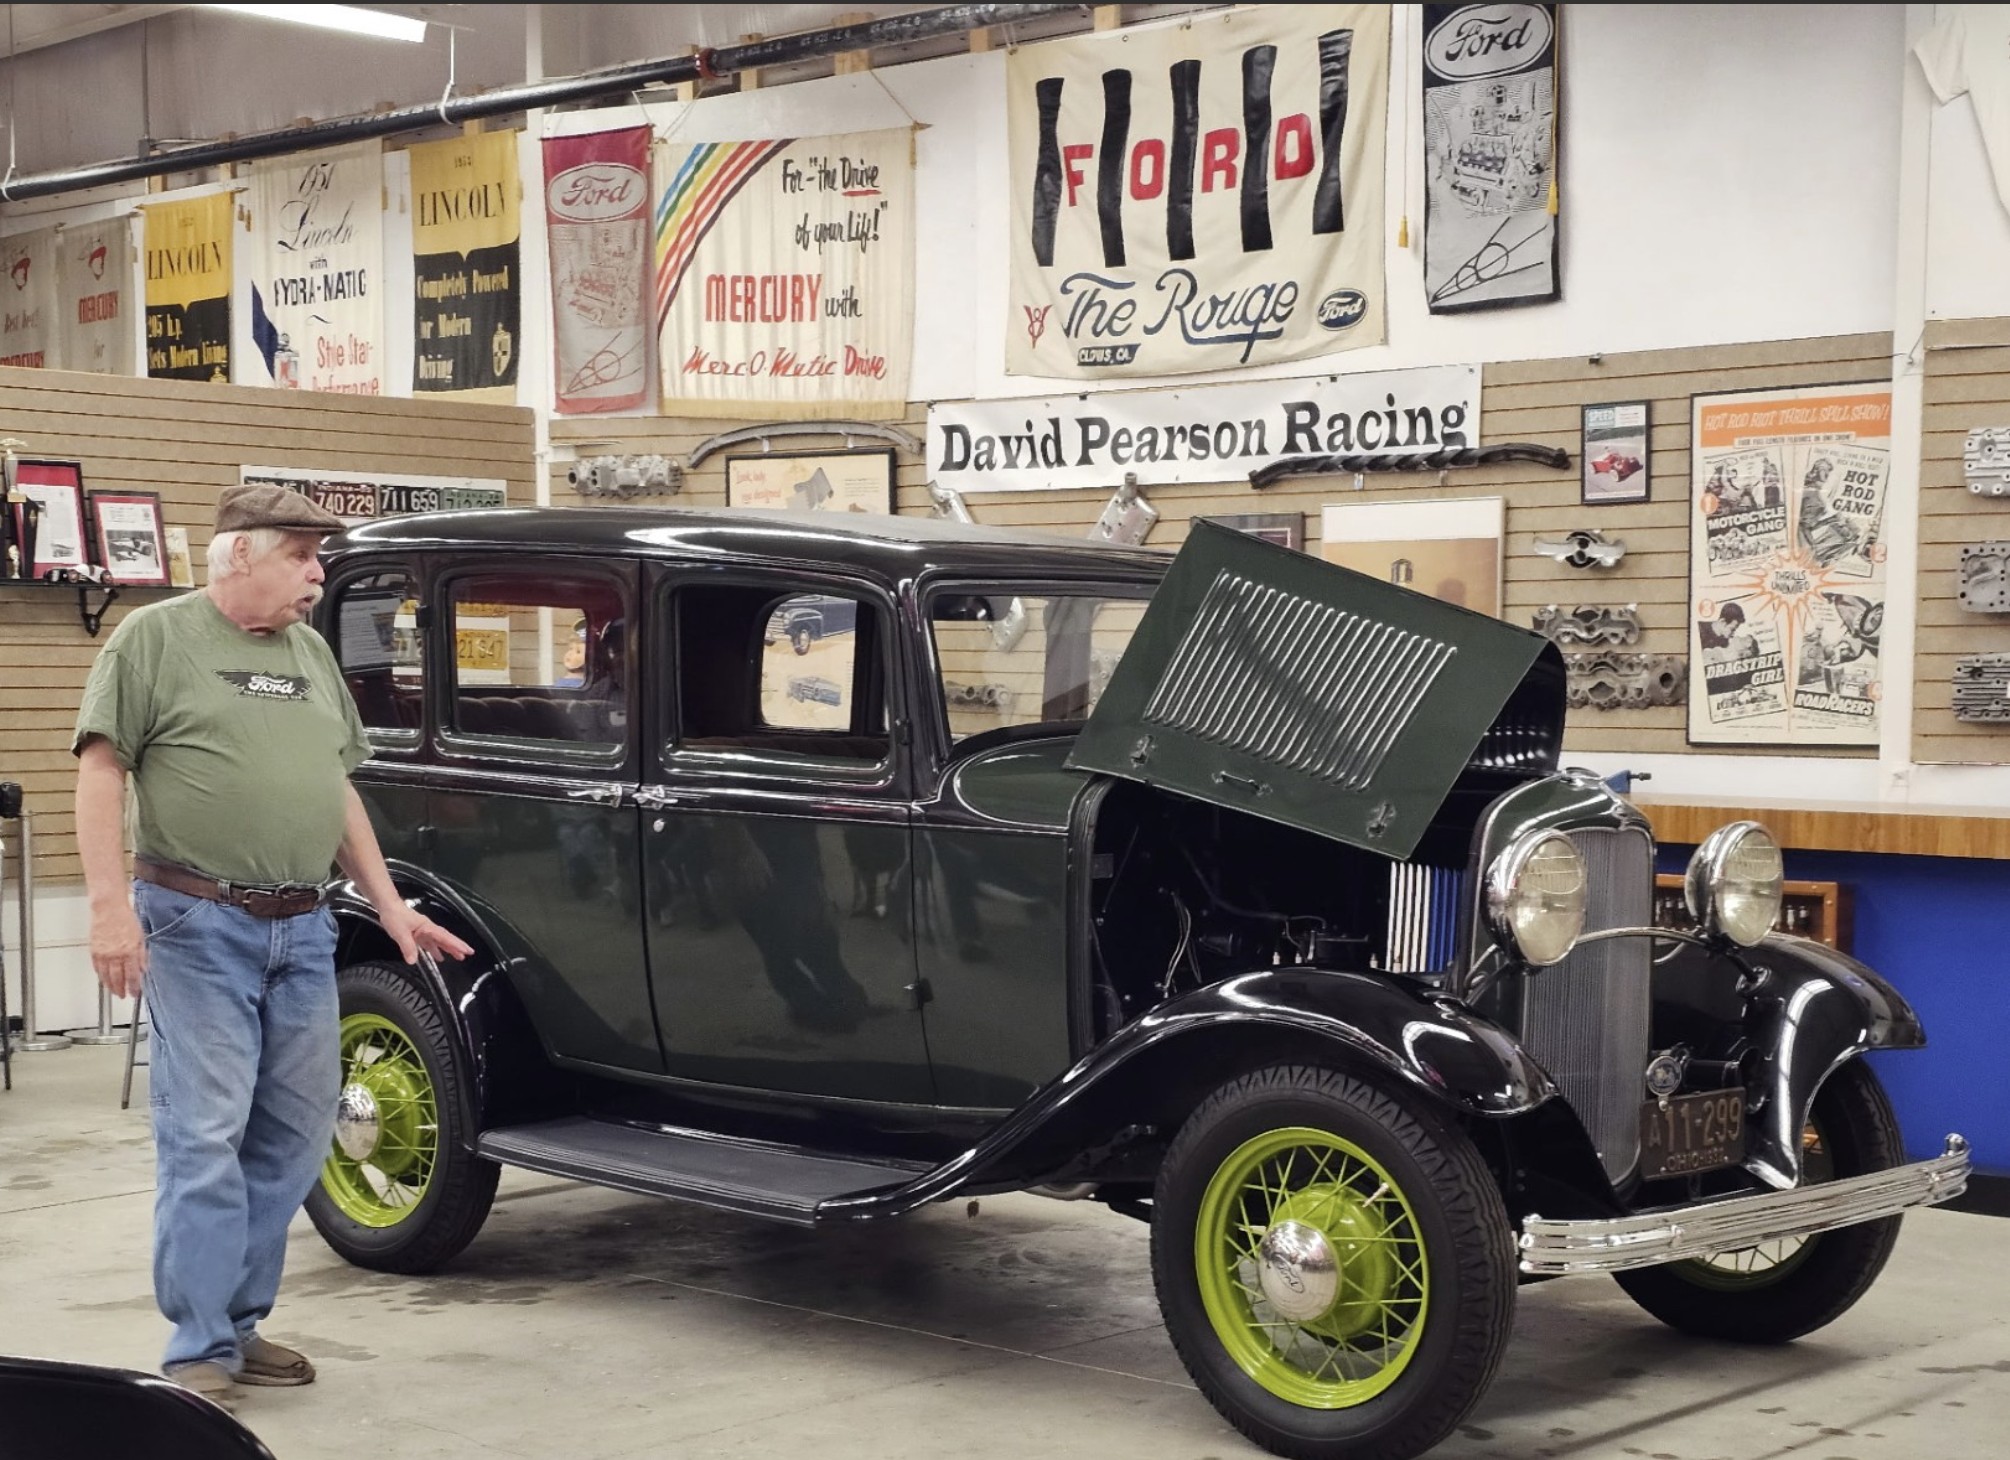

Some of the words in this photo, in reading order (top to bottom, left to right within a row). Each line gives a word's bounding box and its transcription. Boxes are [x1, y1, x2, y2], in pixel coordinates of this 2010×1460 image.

[1445, 15, 1533, 61] Ford
[840, 156, 880, 190] Drive
[420, 181, 506, 227] LINCOLN
[561, 175, 633, 207] Ford
[277, 194, 358, 253] Lincoln
[795, 212, 812, 252] of
[814, 221, 845, 256] your
[148, 241, 223, 281] LINCOLN
[705, 273, 823, 323] MERCURY
[825, 285, 863, 320] with
[1319, 296, 1365, 322] Ford
[1060, 272, 1137, 339] The
[1143, 268, 1299, 364] Rouge
[844, 344, 889, 381] Drive
[938, 416, 1067, 472] David
[1074, 411, 1269, 466] Pearson
[1280, 393, 1469, 452] Racing
[1842, 485, 1876, 500] ROD
[1844, 469, 1880, 487] HOT
[346, 494, 375, 516] 229
[381, 489, 406, 511] 711
[411, 490, 438, 511] 659
[1832, 499, 1876, 516] GANG
[1708, 506, 1786, 530] MOTORCYCLE
[1747, 518, 1786, 535] GANG
[1706, 653, 1783, 679] DRAGSTRIP
[1751, 668, 1785, 686] GIRL
[247, 676, 295, 694] Ford
